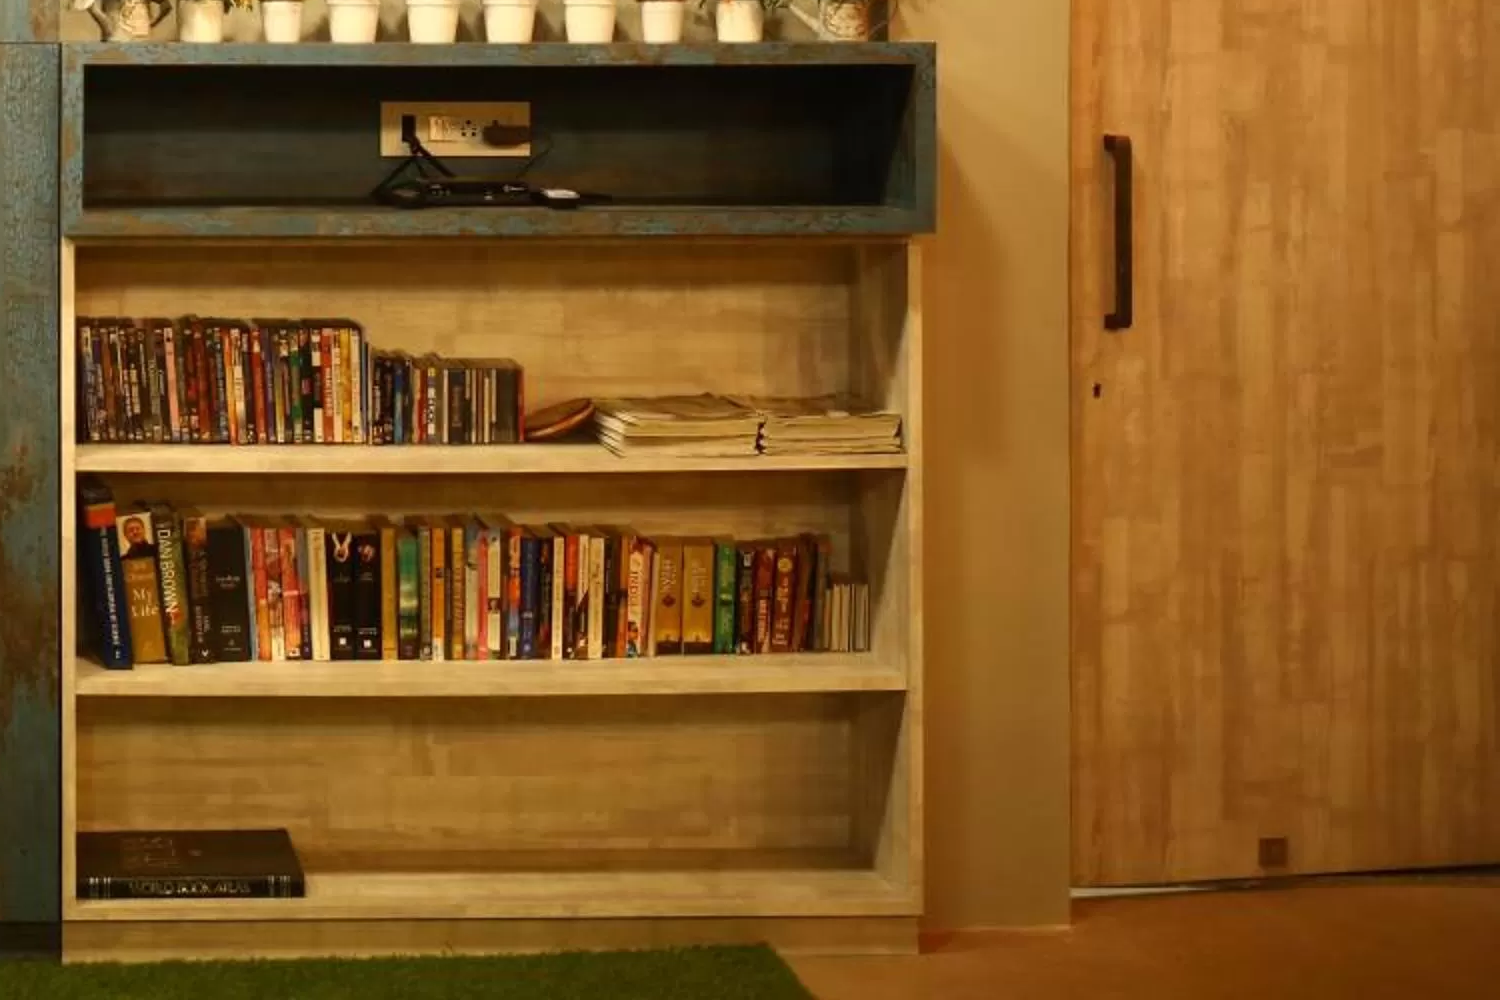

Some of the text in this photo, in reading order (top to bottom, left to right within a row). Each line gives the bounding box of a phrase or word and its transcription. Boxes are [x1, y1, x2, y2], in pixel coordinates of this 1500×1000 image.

[132, 587, 153, 606] My
[156, 529, 180, 614] DAN BROWN
